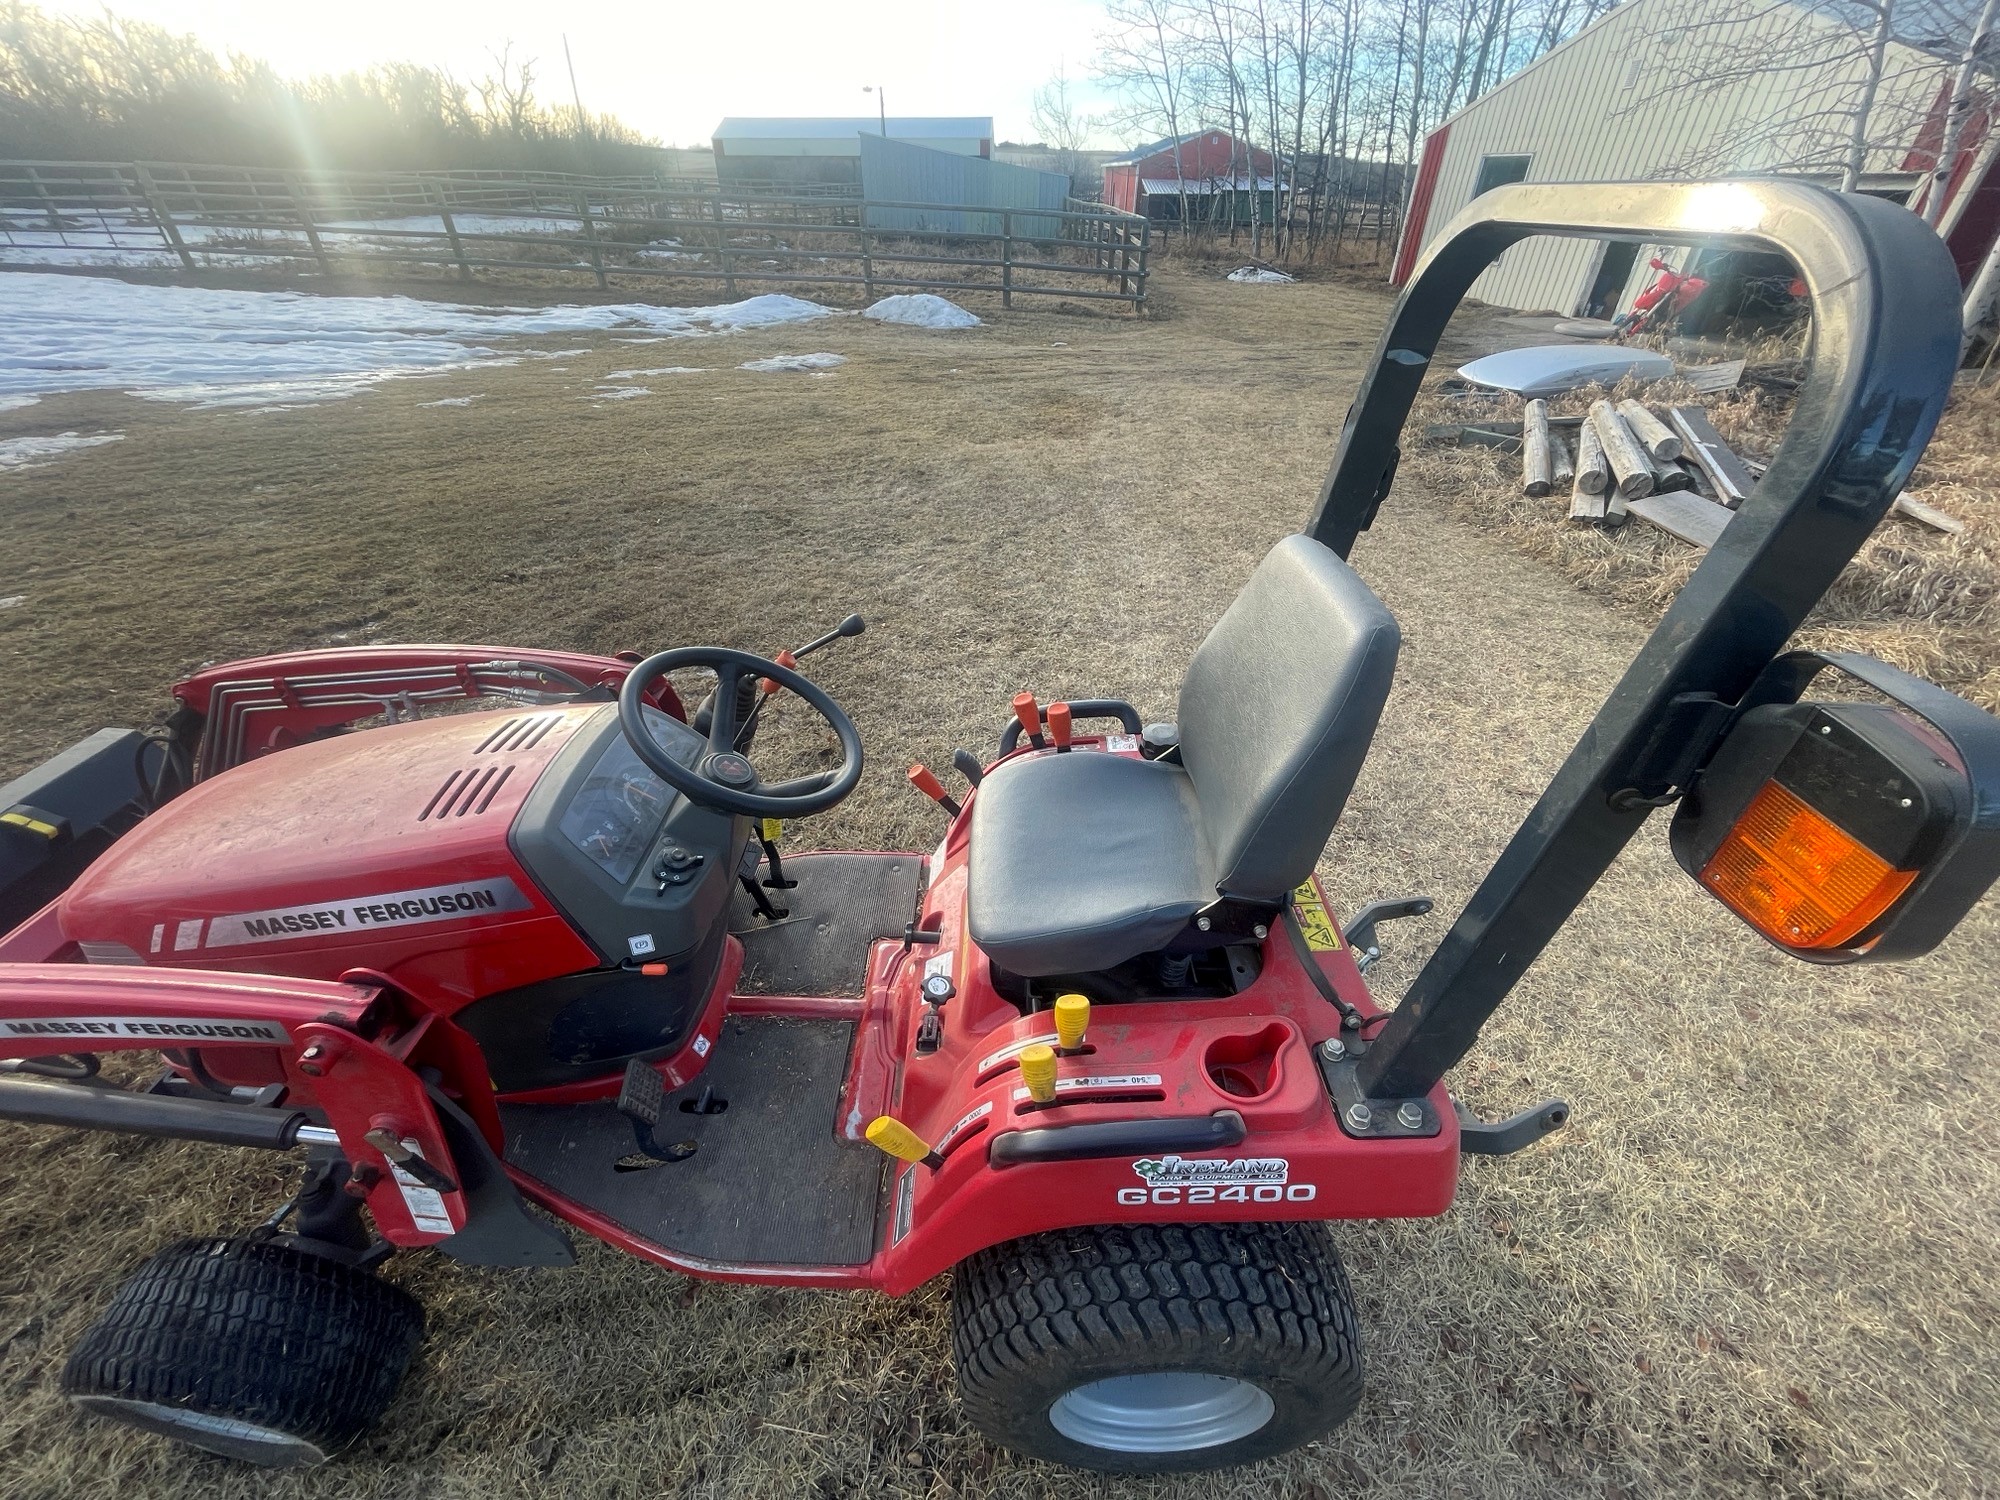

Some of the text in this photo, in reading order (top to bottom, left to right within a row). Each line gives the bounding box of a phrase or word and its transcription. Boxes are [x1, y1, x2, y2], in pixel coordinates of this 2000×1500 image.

[243, 889, 497, 938] MASSEY FERGUSON
[4, 1022, 275, 1039] MASSEY FERGUSON
[1164, 1156, 1287, 1175] IRELAND
[1152, 1174, 1184, 1182] FARM
[1190, 1173, 1251, 1181] EQUIPMENT
[1117, 1184, 1317, 1205] GC2400
